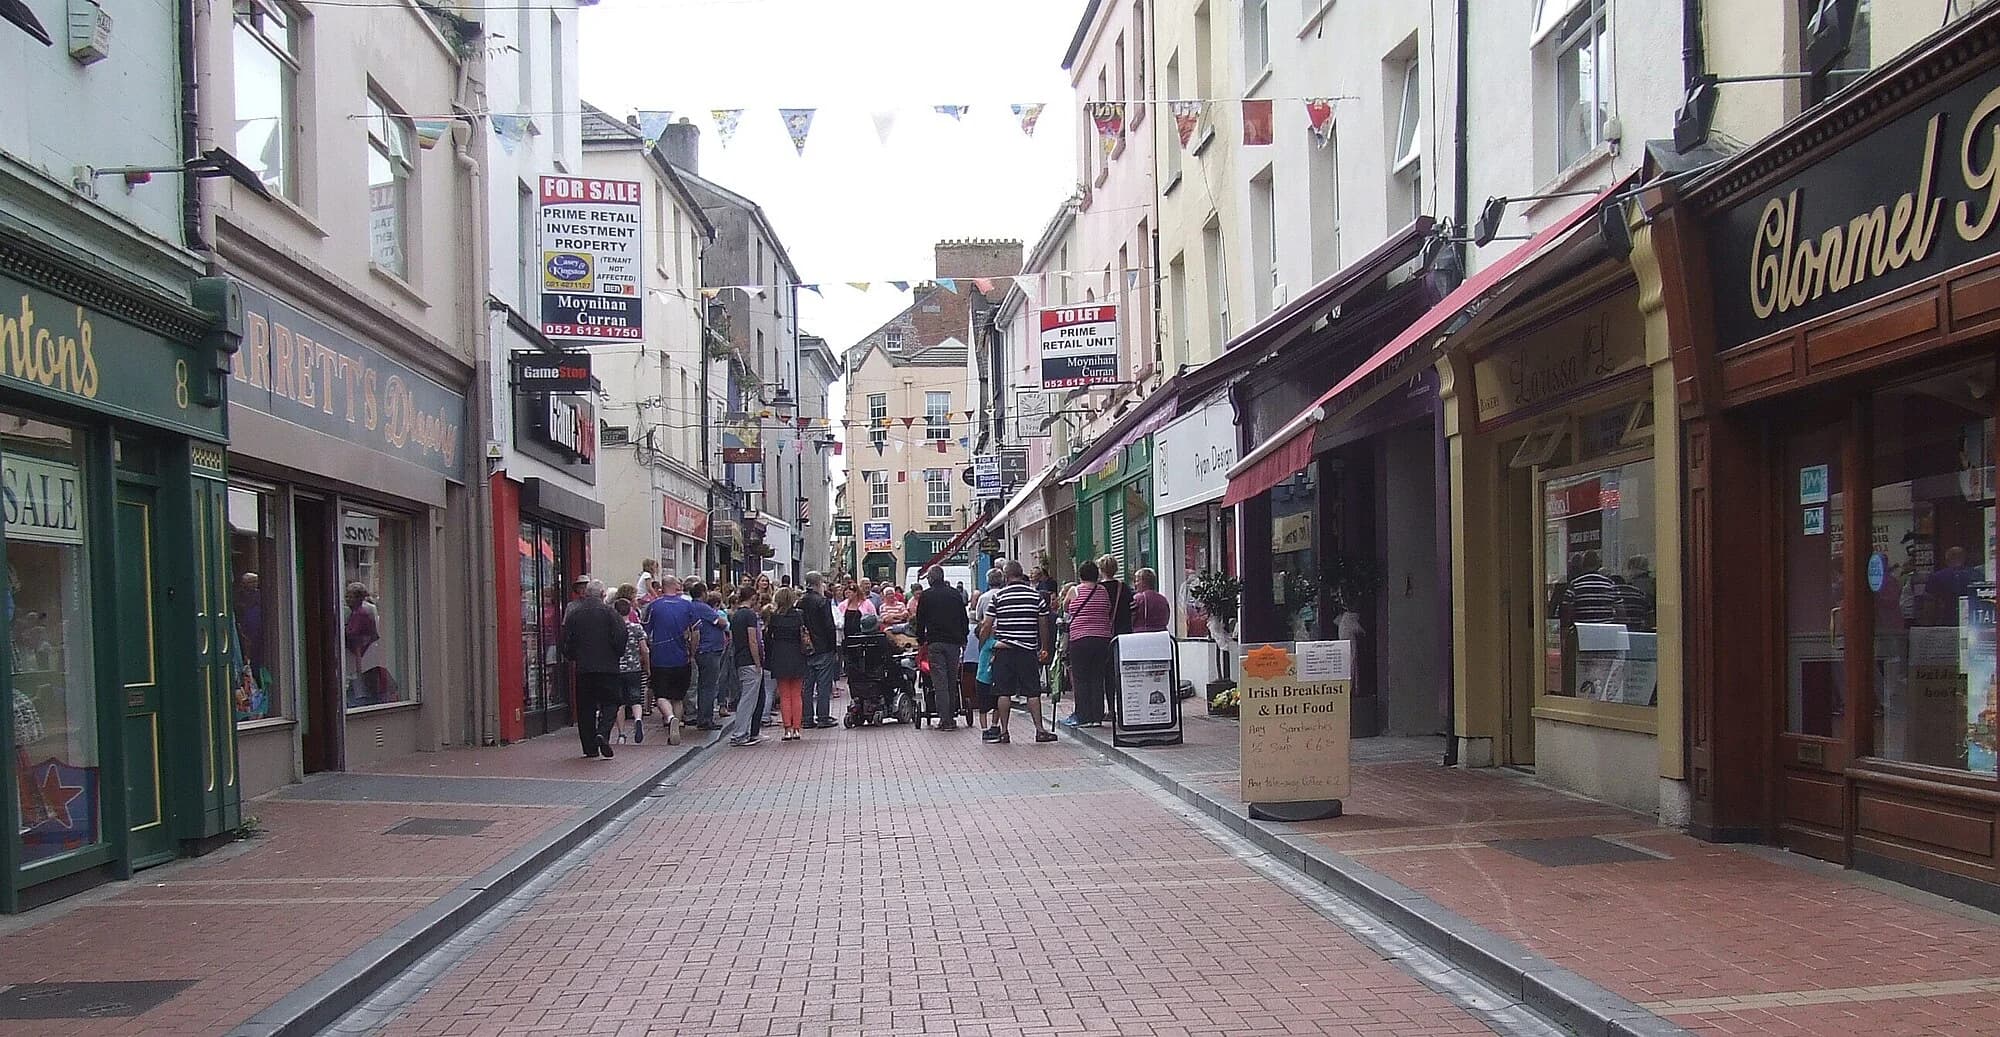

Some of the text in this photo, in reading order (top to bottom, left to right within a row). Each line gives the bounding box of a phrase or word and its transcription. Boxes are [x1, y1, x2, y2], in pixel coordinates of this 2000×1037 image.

[544, 178, 638, 202] FOR SALE
[543, 208, 638, 223] PRIME RETAIL
[1751, 112, 1942, 319] Clonmel
[547, 223, 635, 238] INVESTMENT
[555, 239, 627, 252] PROPERTY
[596, 274, 636, 283] AFFECTED)
[558, 296, 627, 311] Moynihan
[577, 312, 627, 326] Curran
[1056, 308, 1100, 323] TO LET
[546, 325, 638, 338] 052 612 1750
[1060, 327, 1097, 338] PRIME
[1043, 337, 1115, 351] RETAIL UNIT
[1067, 356, 1114, 368] Moynihan
[524, 366, 588, 379] GameStop
[1081, 367, 1114, 377] Curran
[176, 359, 188, 409] 8
[1044, 380, 1063, 388] 052
[1195, 453, 1210, 483] Ryan
[1212, 445, 1234, 472] Design
[4, 468, 77, 531] SALE
[1248, 684, 1344, 699] Irish Breakfast
[1258, 701, 1334, 716] & Hot Food
